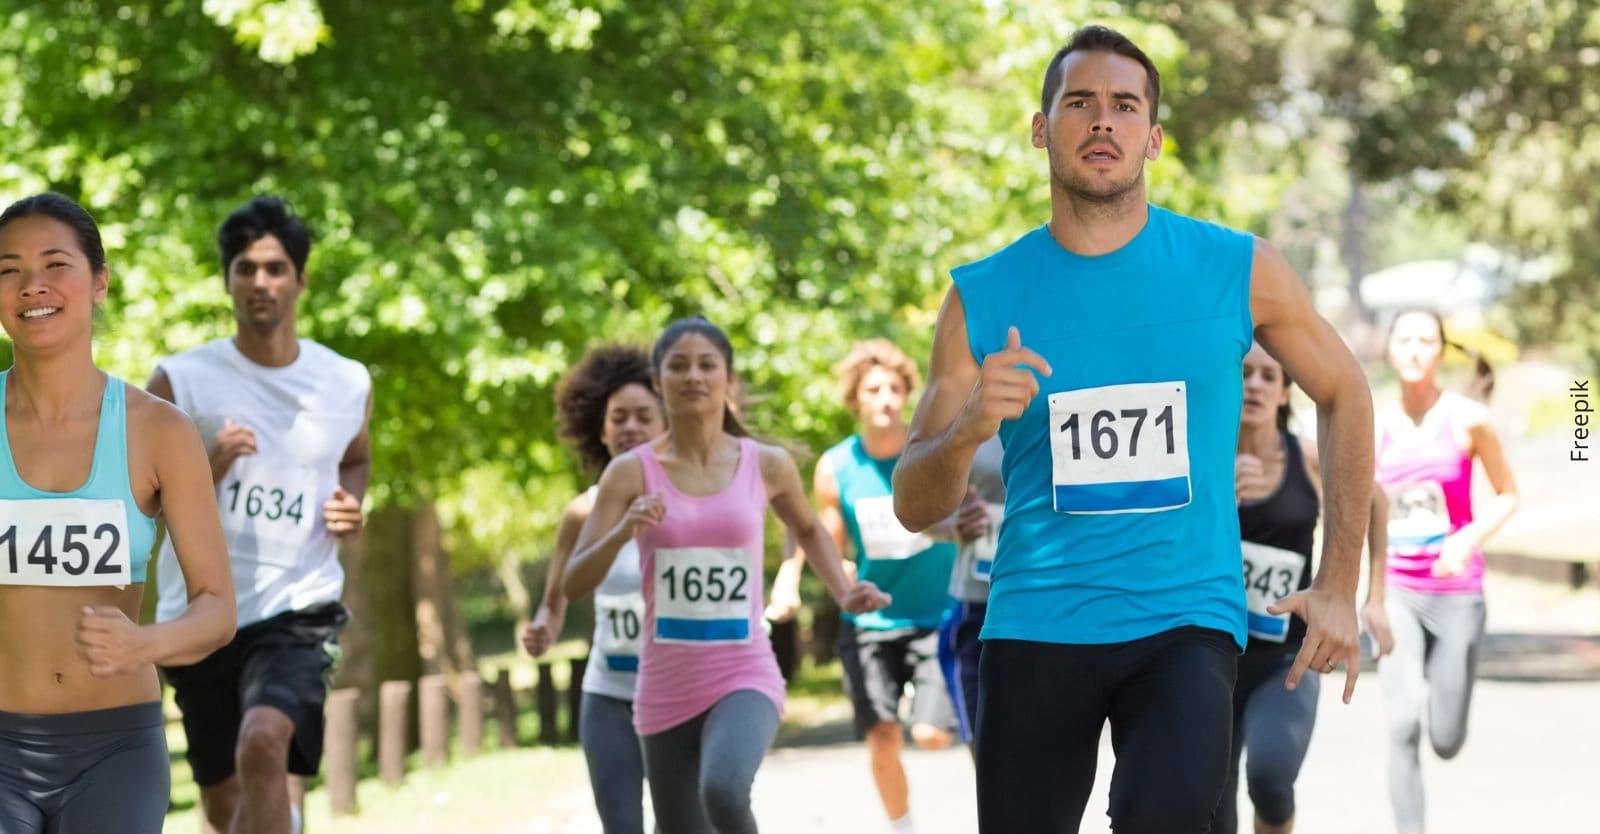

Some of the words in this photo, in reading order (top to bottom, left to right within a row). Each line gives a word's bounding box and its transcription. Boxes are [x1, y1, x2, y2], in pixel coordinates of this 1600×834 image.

[1060, 405, 1175, 460] 1671
[227, 479, 304, 524] 1634
[0, 523, 122, 575] 1452
[662, 566, 747, 602] 1652
